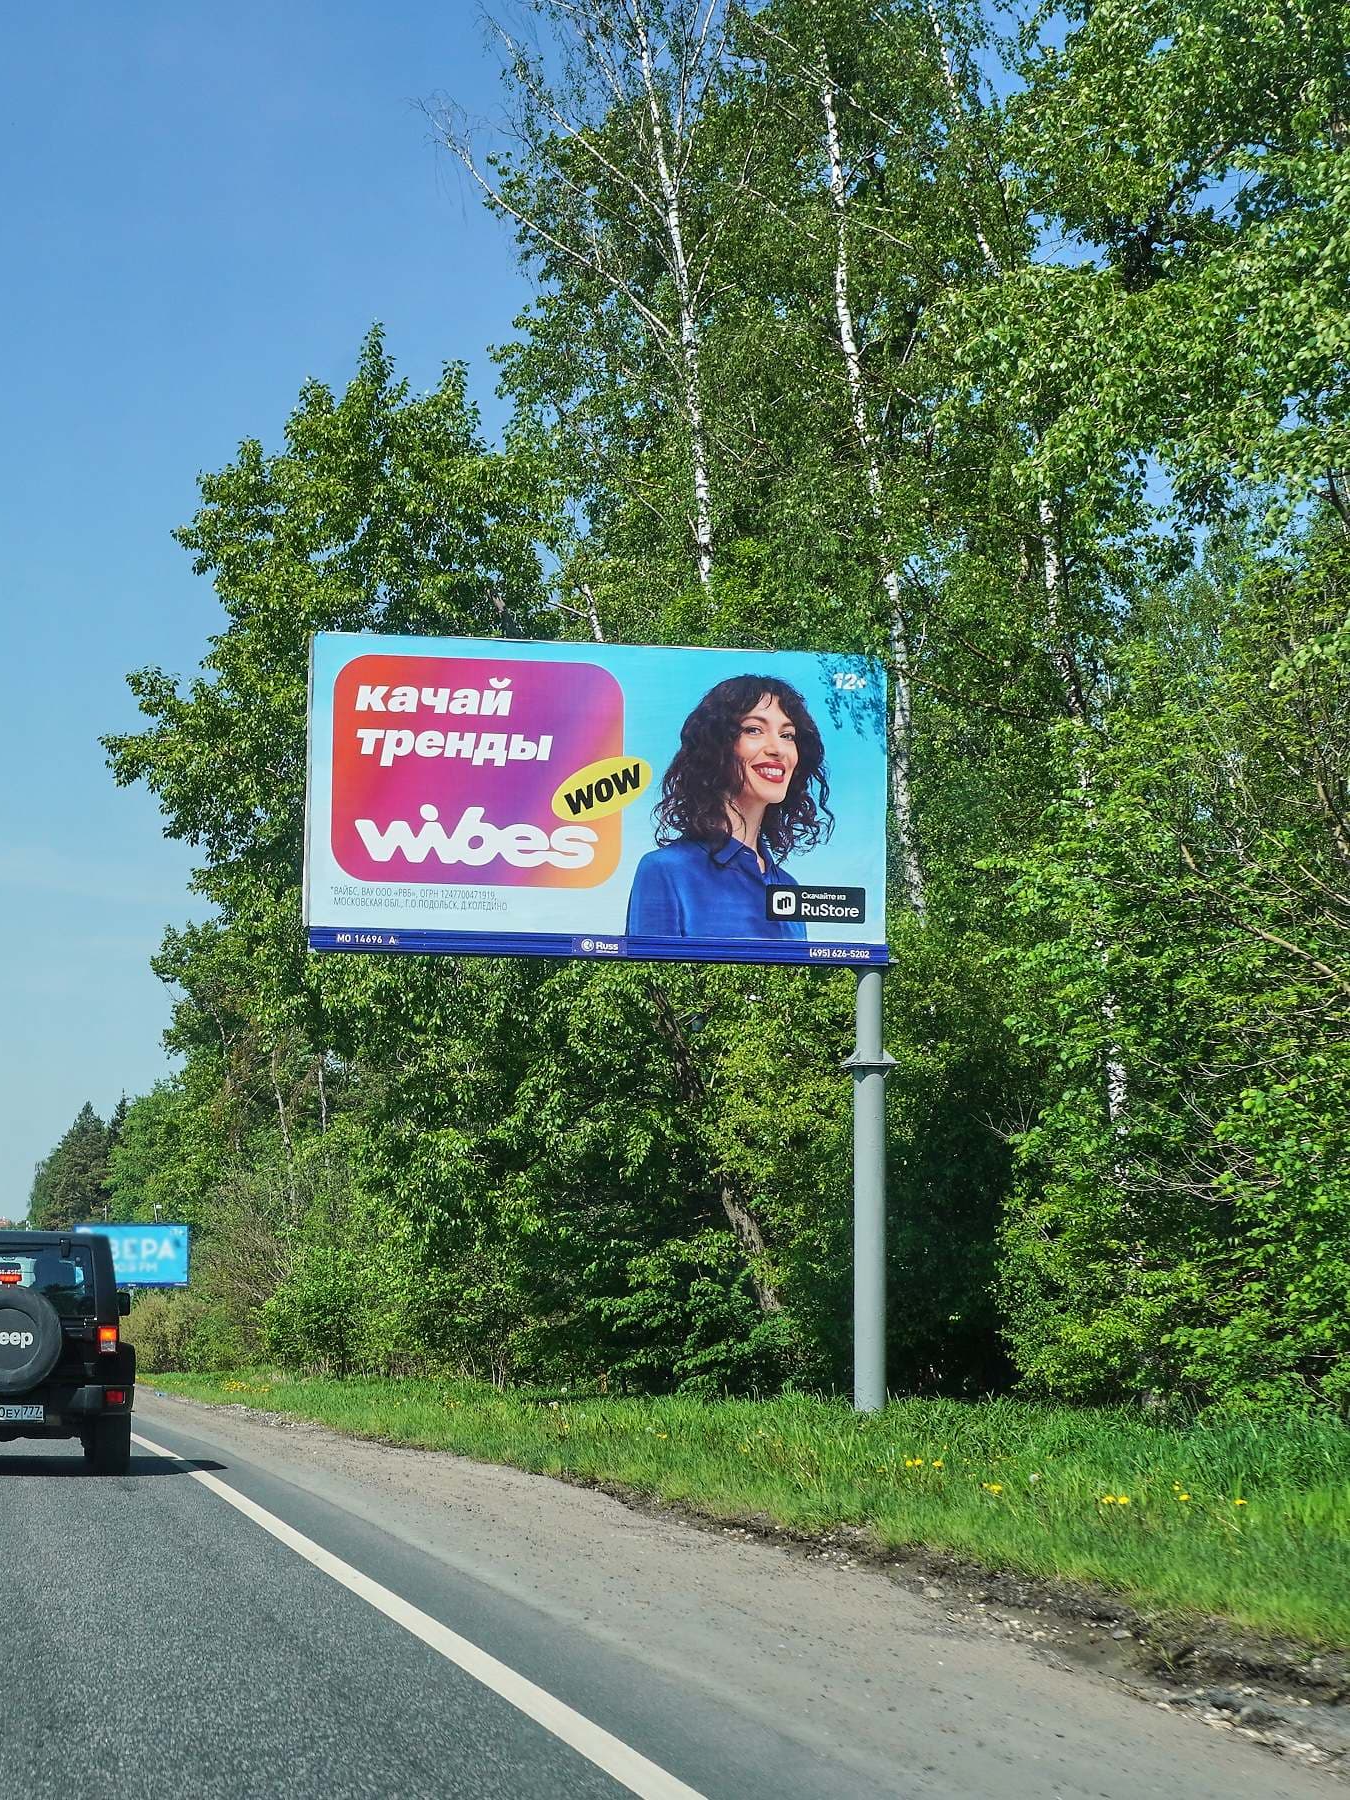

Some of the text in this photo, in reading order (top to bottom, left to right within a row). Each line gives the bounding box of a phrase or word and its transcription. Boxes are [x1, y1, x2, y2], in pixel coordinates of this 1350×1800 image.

[354, 677, 513, 716] качай
[355, 728, 554, 767] тренды
[564, 763, 641, 816] WOW
[354, 803, 599, 869] wibes
[375, 887, 392, 897] ООО
[419, 888, 439, 899] ОГРН
[801, 891, 836, 900] Скачайте
[333, 896, 383, 907] МОСКОВСКАЯ
[801, 902, 860, 918] RuStore
[354, 934, 383, 944] 14696
[595, 941, 619, 950] Russ
[809, 948, 870, 959] (495) 626-5202
